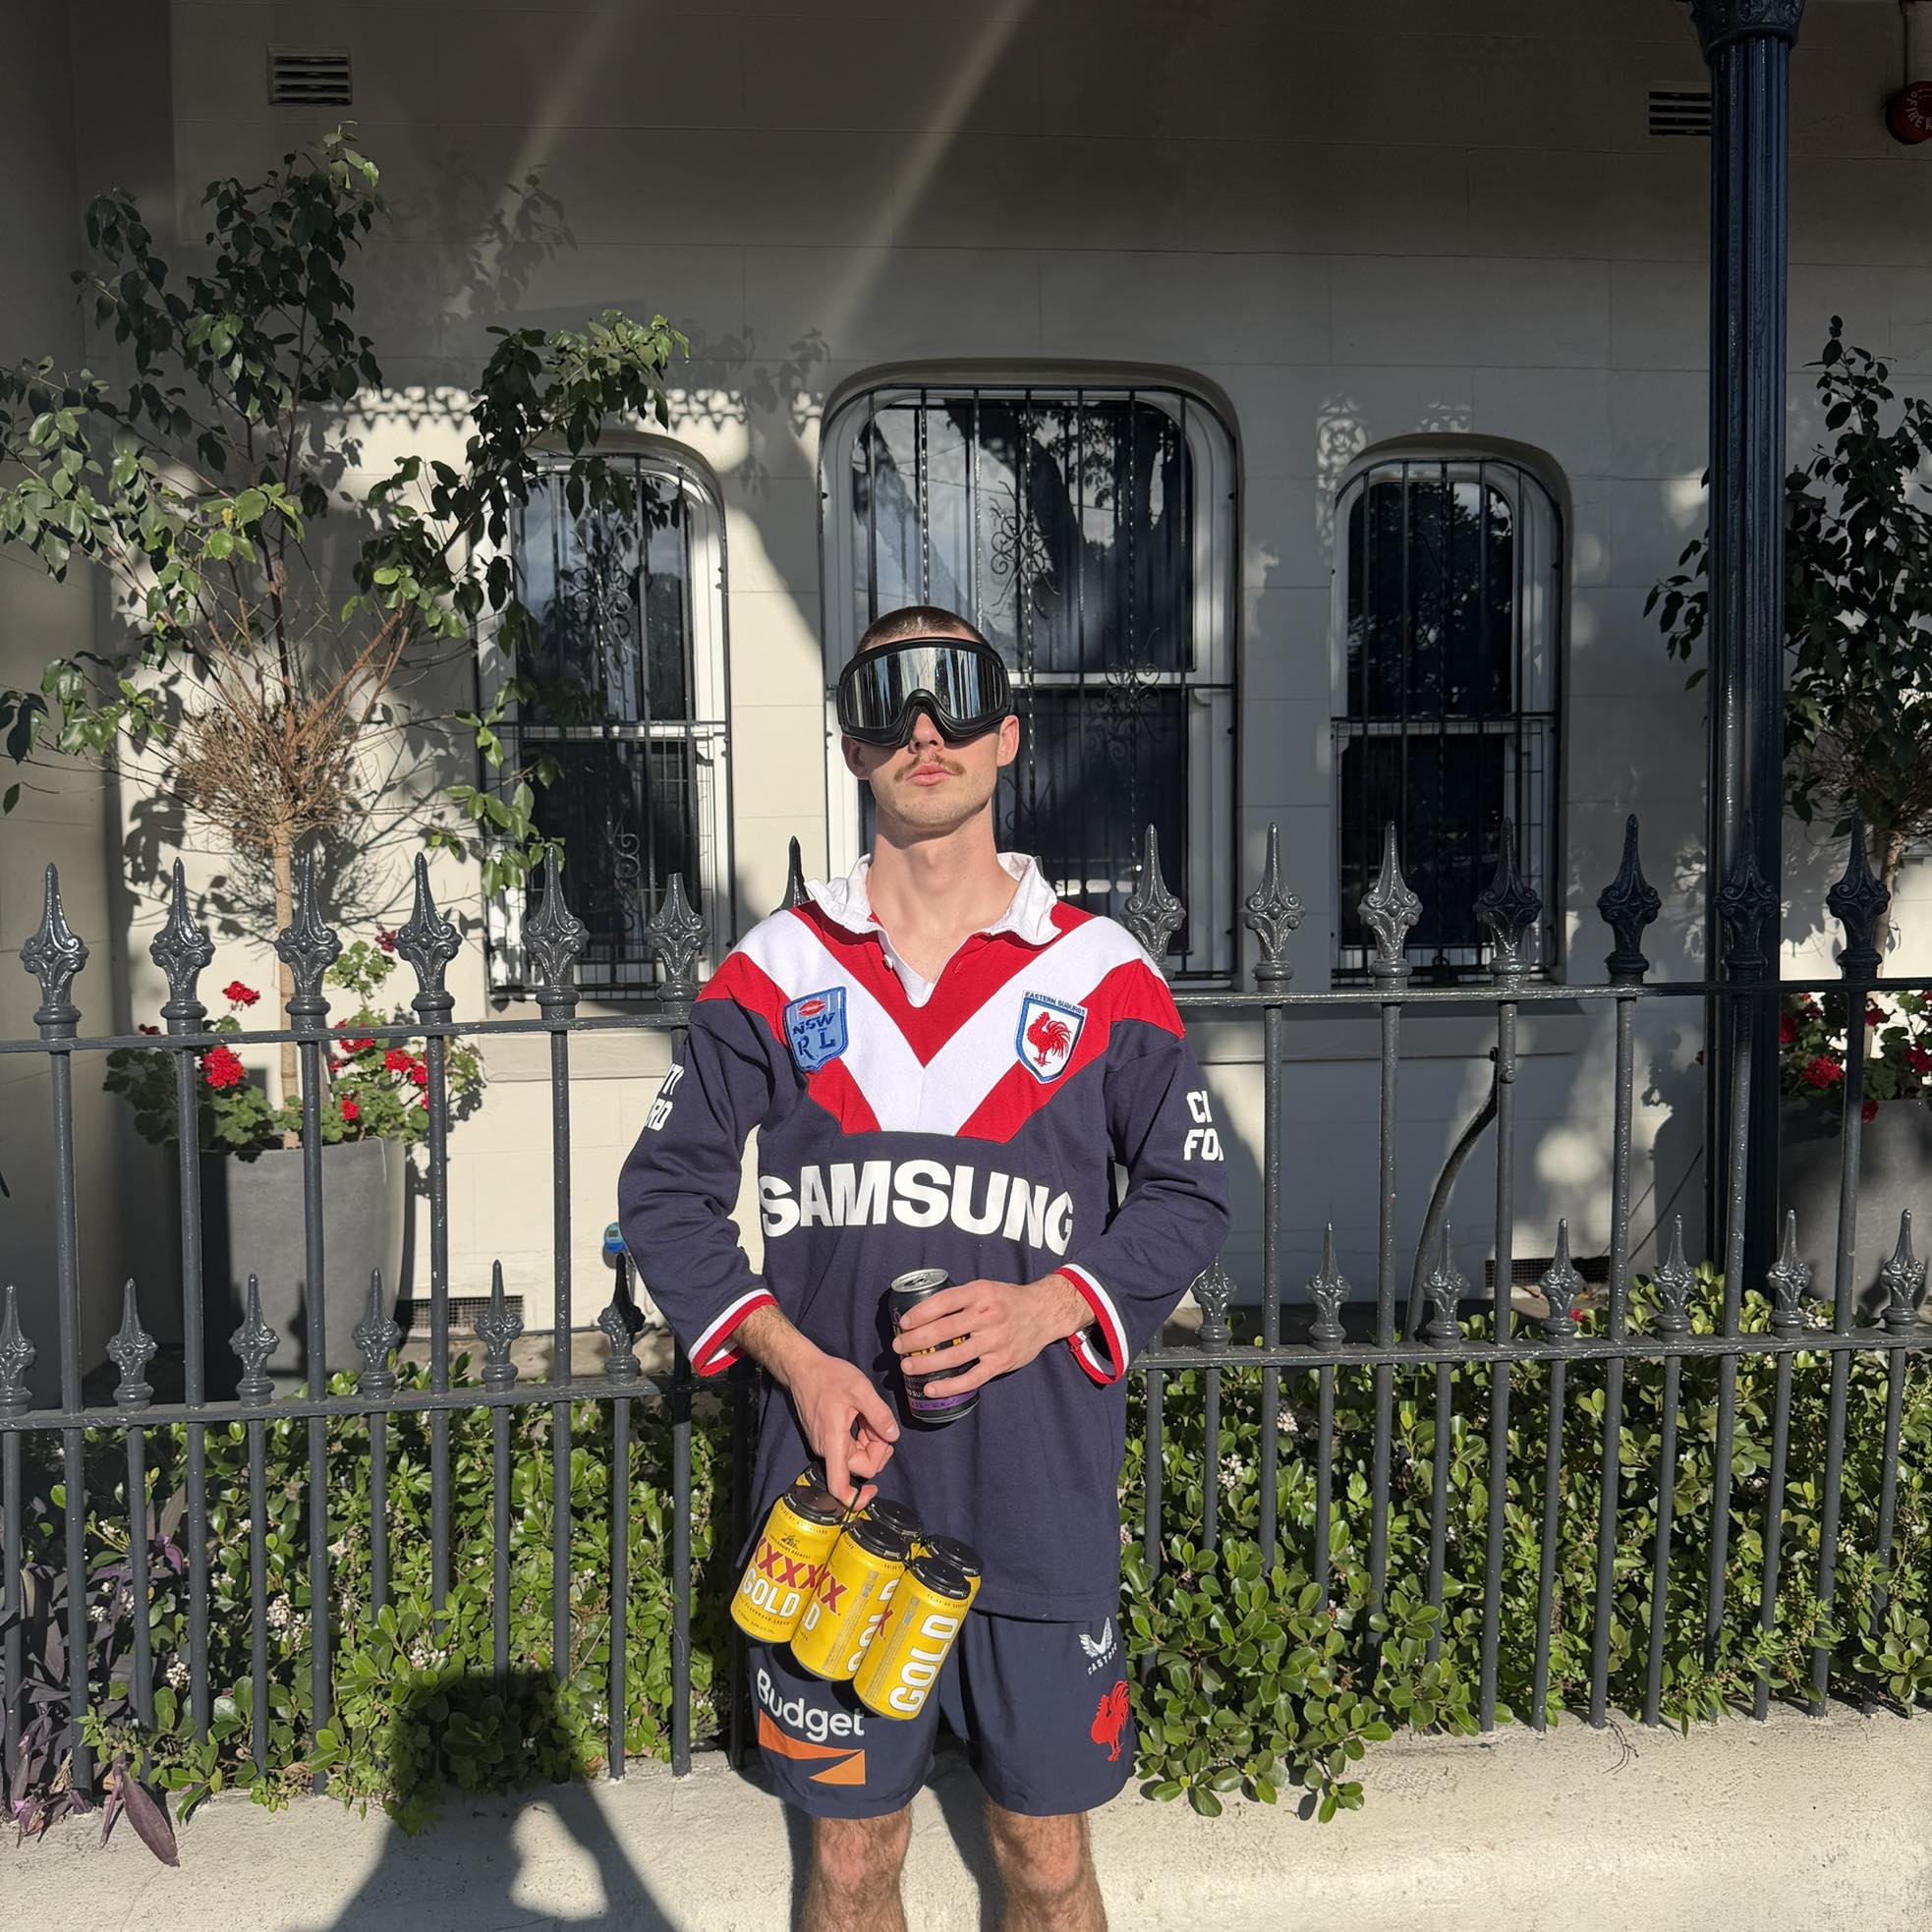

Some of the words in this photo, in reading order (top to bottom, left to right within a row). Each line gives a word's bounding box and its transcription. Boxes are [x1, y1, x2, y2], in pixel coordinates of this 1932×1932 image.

[793, 1012, 835, 1035] NSW
[1025, 992, 1056, 1005] EASTERN
[1057, 999, 1086, 1016] SUBURBS
[1183, 1128, 1224, 1161] FO
[759, 1160, 1073, 1256] SAMSUNG
[742, 1567, 801, 1619] GOLD
[888, 1614, 959, 1713] GOLD
[757, 1668, 865, 1742] Budget
